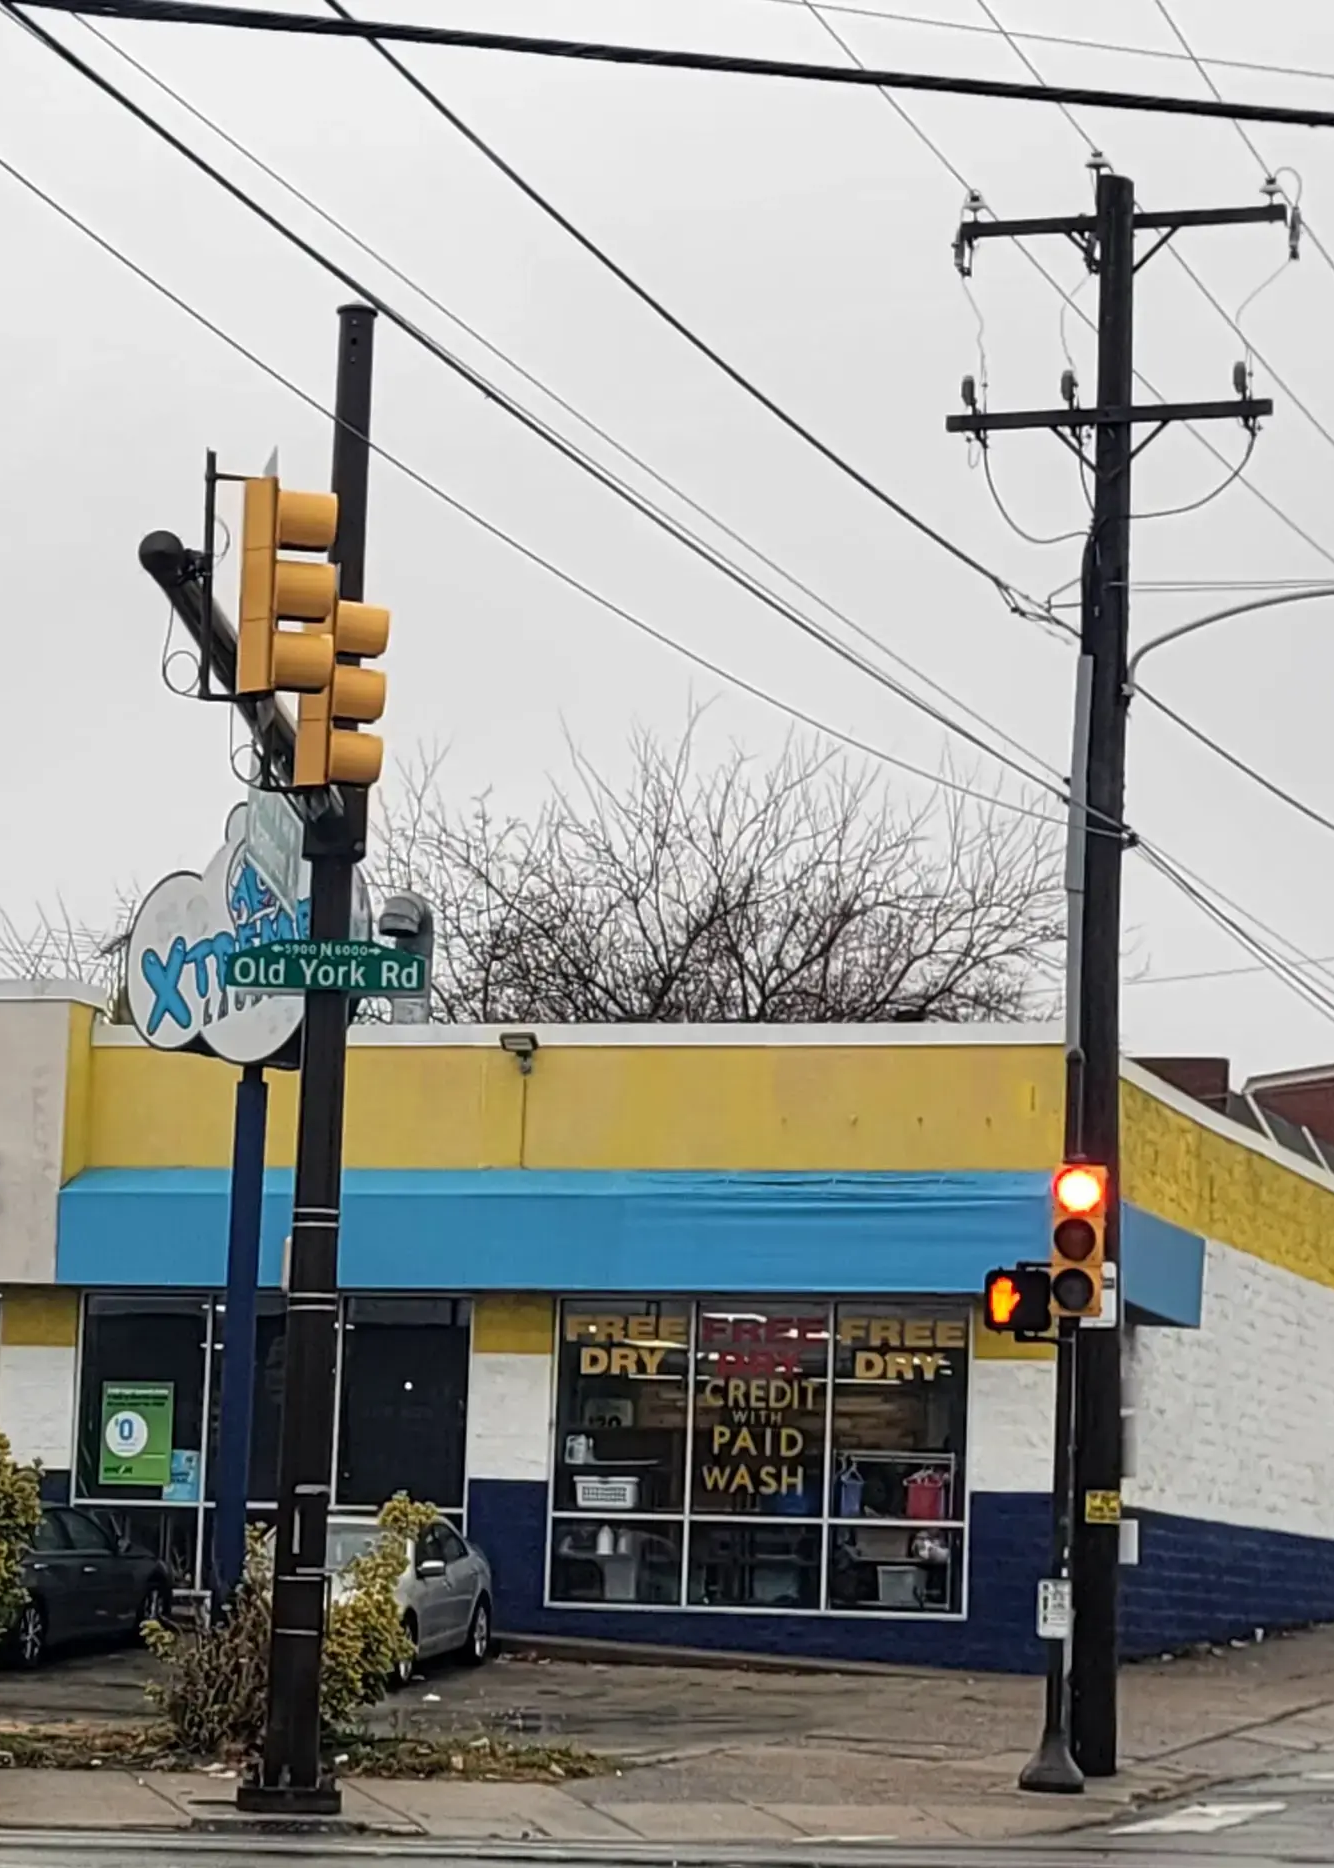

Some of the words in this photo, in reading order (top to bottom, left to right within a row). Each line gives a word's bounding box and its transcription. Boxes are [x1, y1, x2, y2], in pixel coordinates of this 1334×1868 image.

[285, 943, 317, 955] 5900
[320, 941, 333, 956] N
[334, 945, 368, 956] 6000
[234, 957, 285, 985] Old
[299, 959, 366, 987] York
[380, 960, 418, 988] Rd
[567, 1315, 688, 1343] FREE
[703, 1317, 826, 1343] FREE
[839, 1317, 965, 1349] FREE
[580, 1347, 666, 1375] DRY
[854, 1351, 943, 1380] DRY
[705, 1378, 819, 1411] CREDIT
[732, 1409, 782, 1425] WITH
[713, 1426, 804, 1458] PAID
[703, 1464, 804, 1496] WASH
